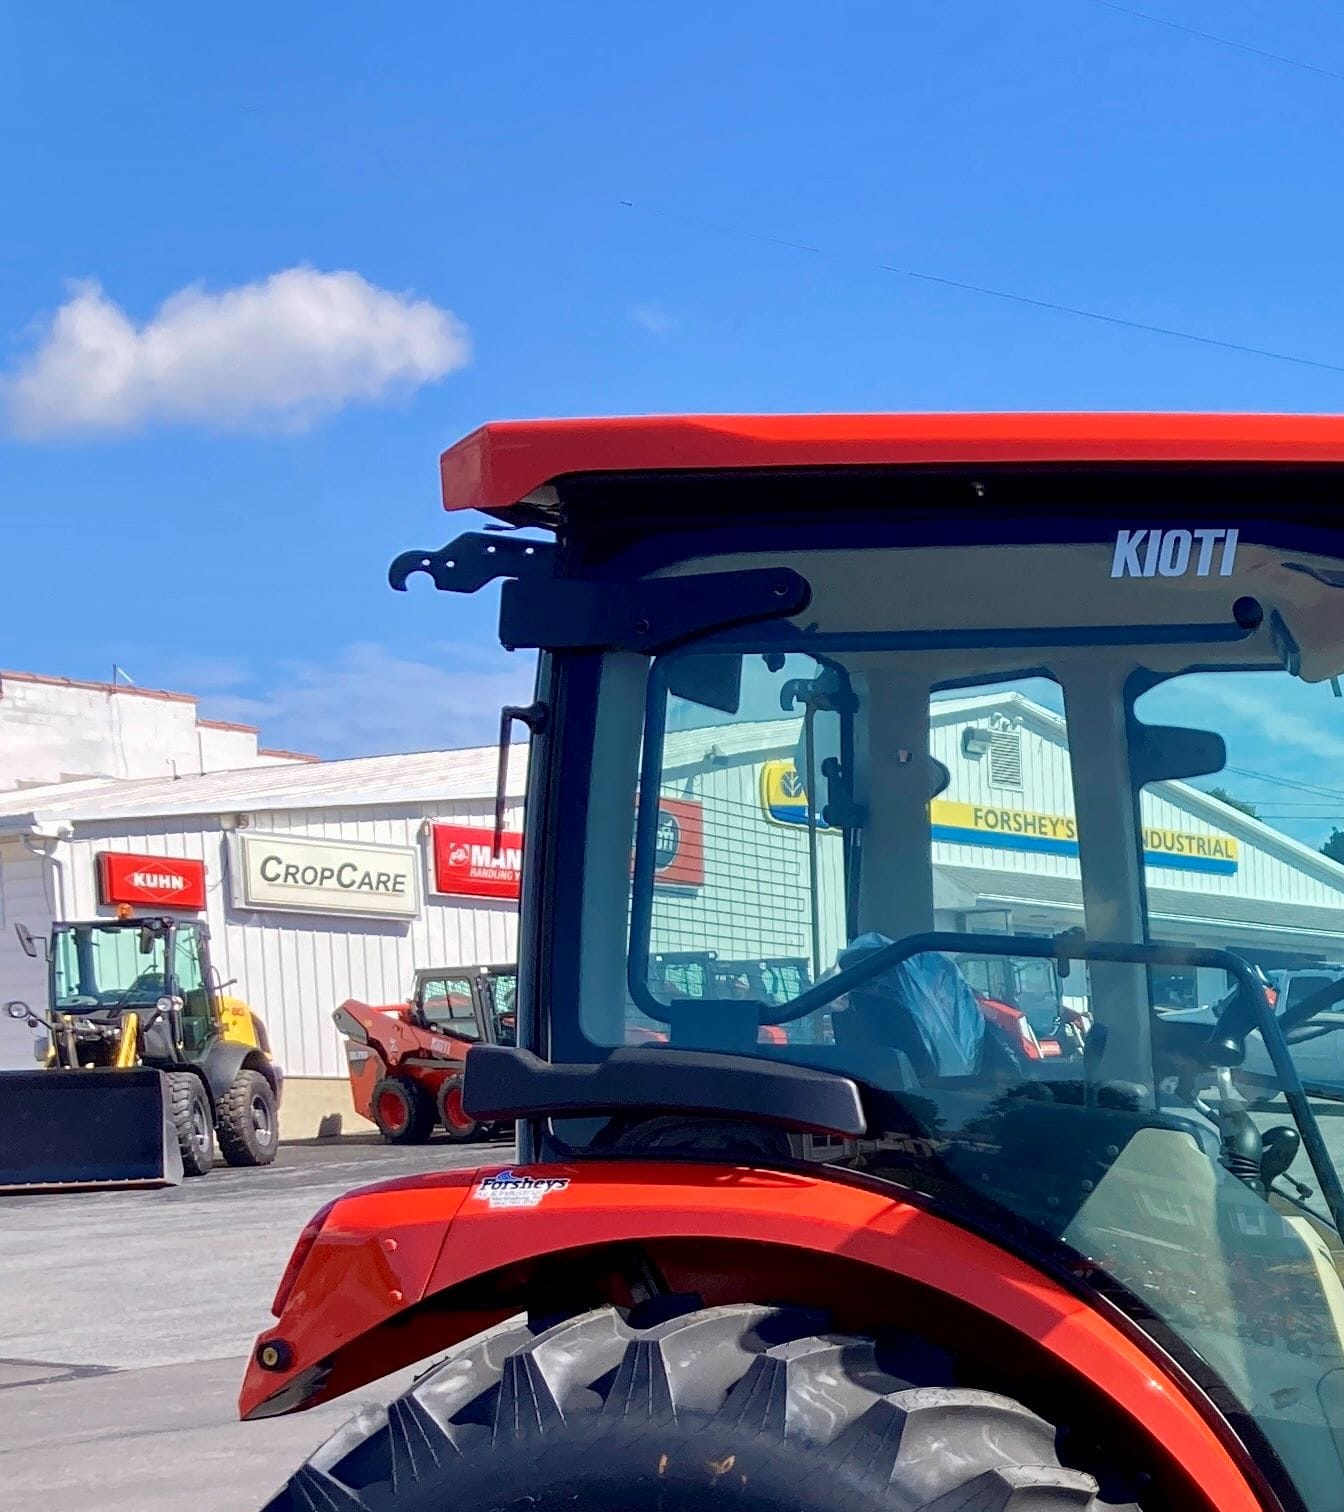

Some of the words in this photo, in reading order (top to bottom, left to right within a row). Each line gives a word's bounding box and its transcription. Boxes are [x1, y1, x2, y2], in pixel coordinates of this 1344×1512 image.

[1111, 528, 1239, 578] KIOTI
[973, 807, 1076, 839] FORSHEY'S
[1142, 829, 1234, 859] DUSTRIAL
[471, 844, 522, 871] MAN
[133, 872, 184, 890] KUHN
[470, 867, 513, 881] HANDLING
[480, 1178, 570, 1191] Forsheys
